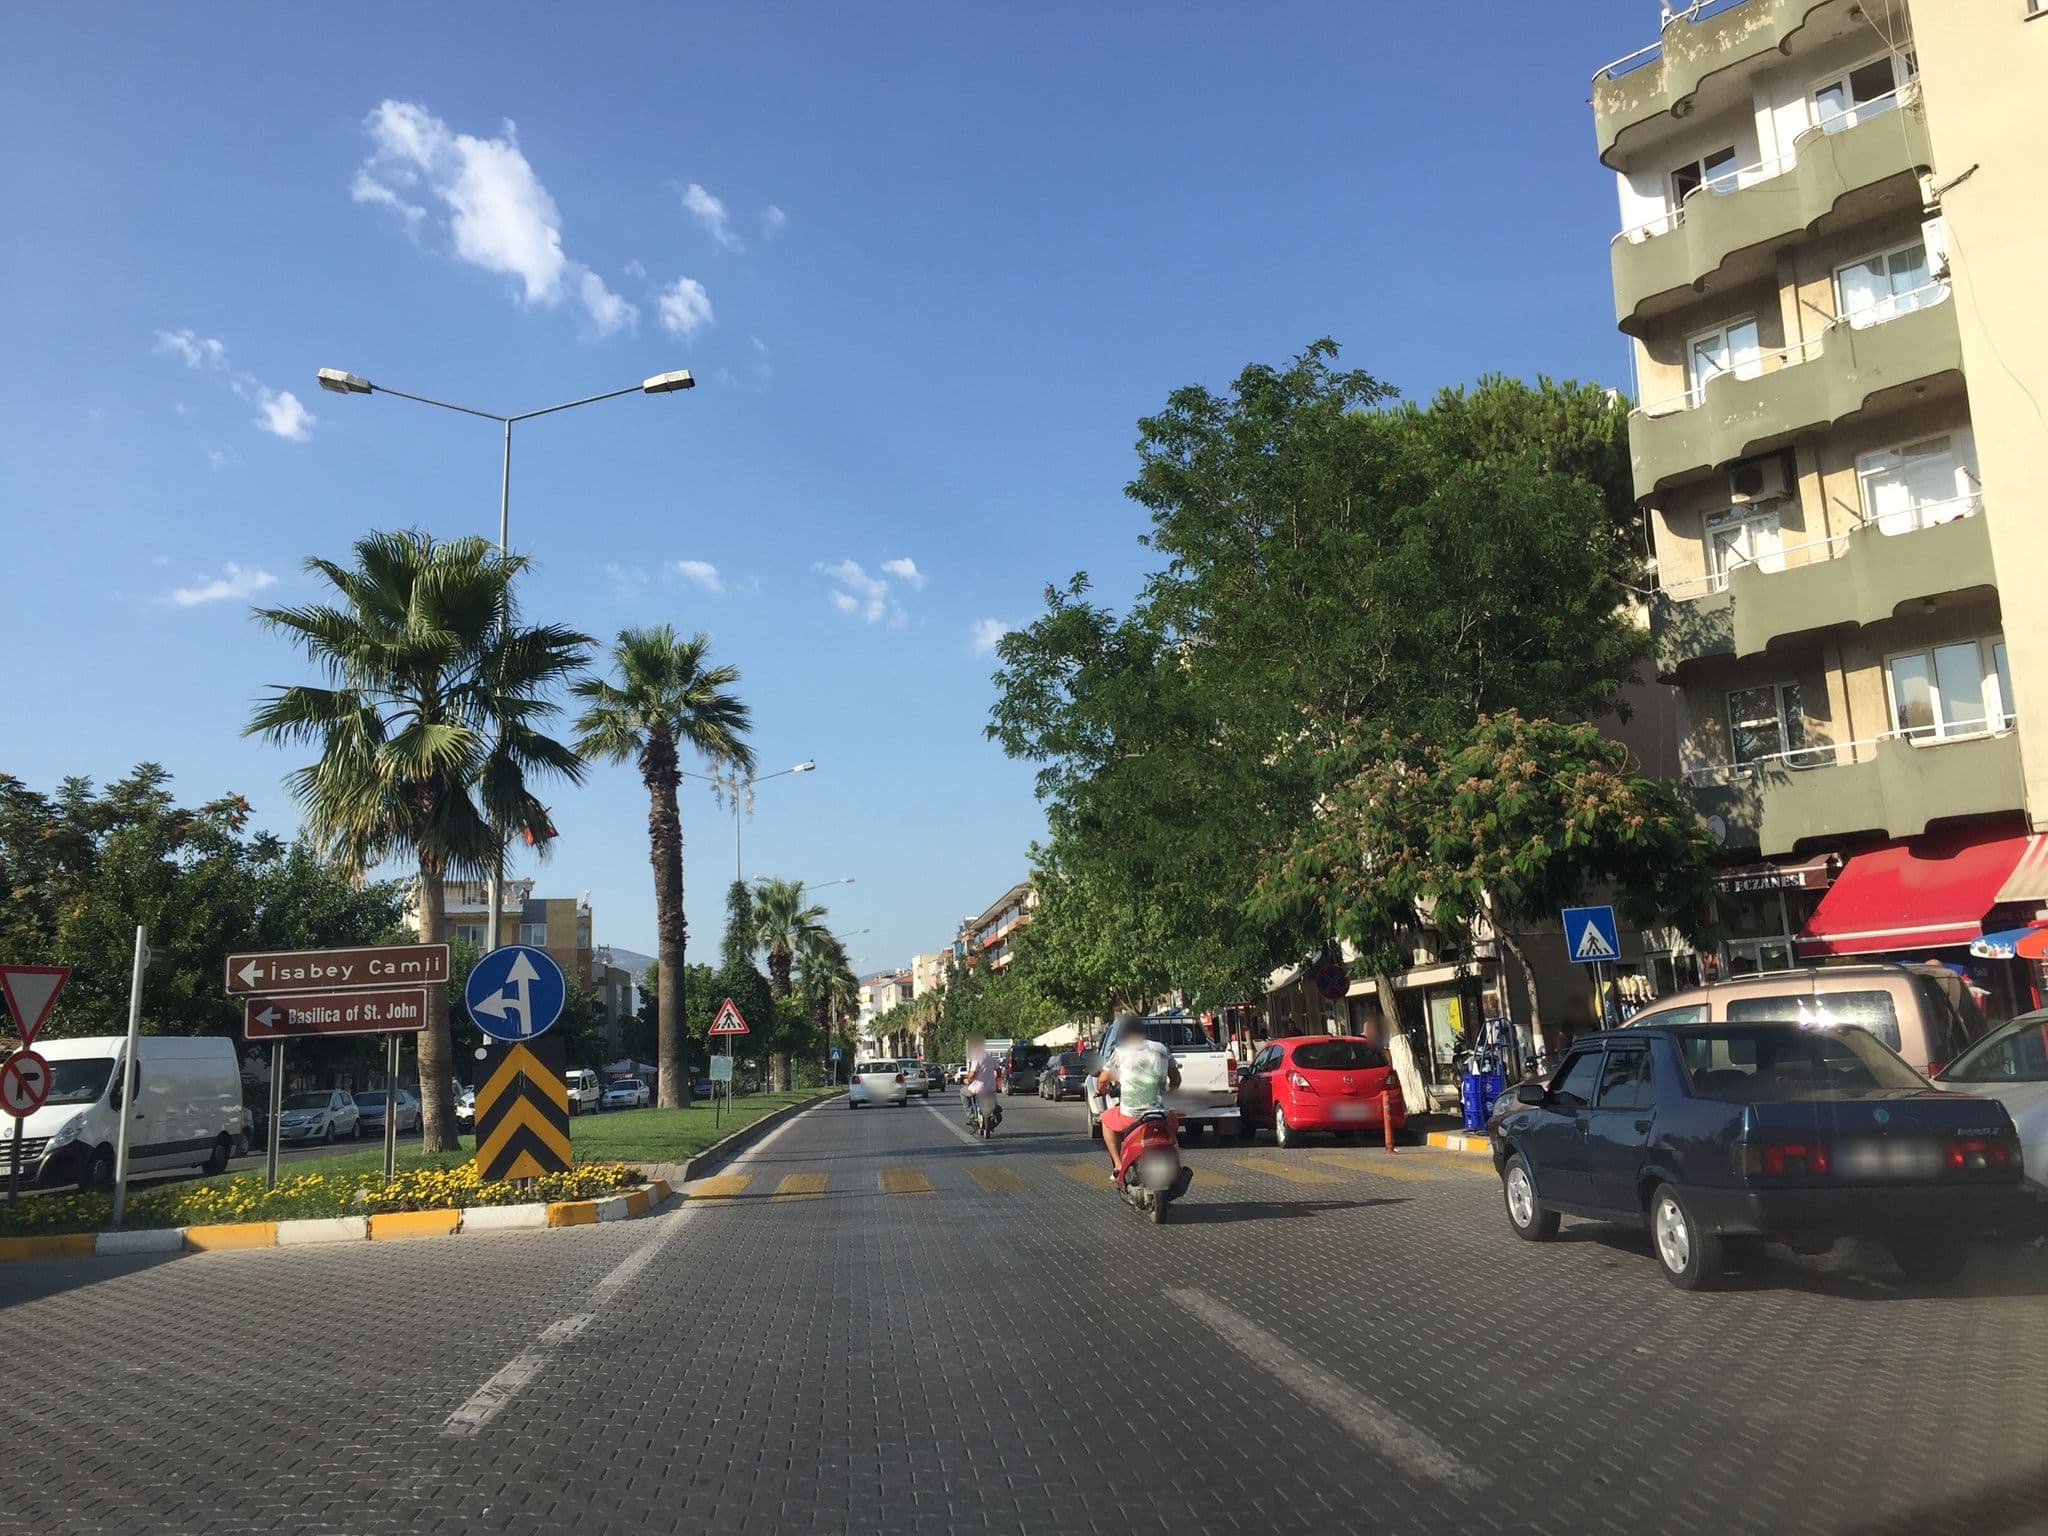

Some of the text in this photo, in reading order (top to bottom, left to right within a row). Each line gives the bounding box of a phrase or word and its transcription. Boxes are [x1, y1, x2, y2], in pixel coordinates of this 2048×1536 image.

[369, 957, 439, 975] Camii
[288, 1002, 417, 1025] Basilica of St. John
